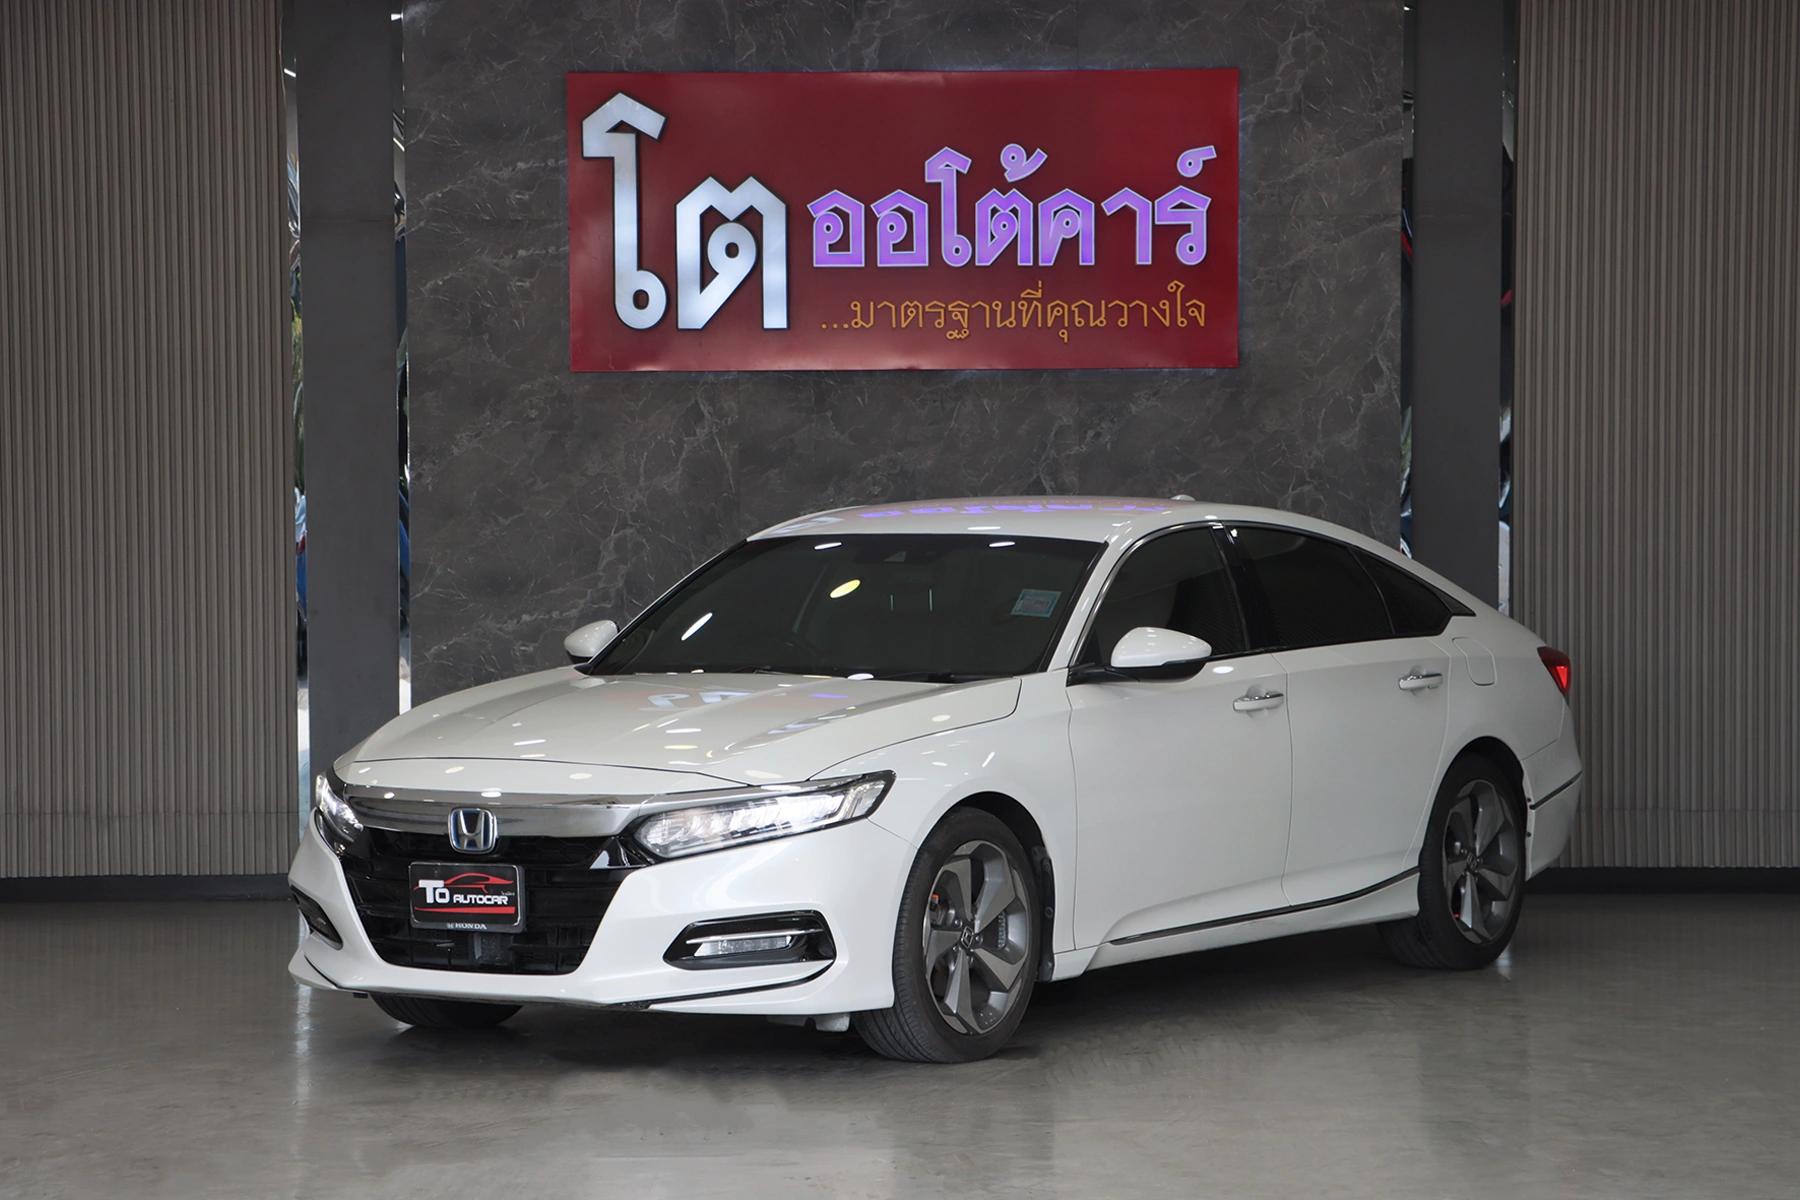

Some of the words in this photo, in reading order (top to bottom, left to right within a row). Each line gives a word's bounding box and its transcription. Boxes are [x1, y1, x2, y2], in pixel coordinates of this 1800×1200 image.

[582, 92, 788, 330] โต
[807, 143, 1217, 268] ออโต้คาร์
[453, 894, 509, 905] AUTOCAR
